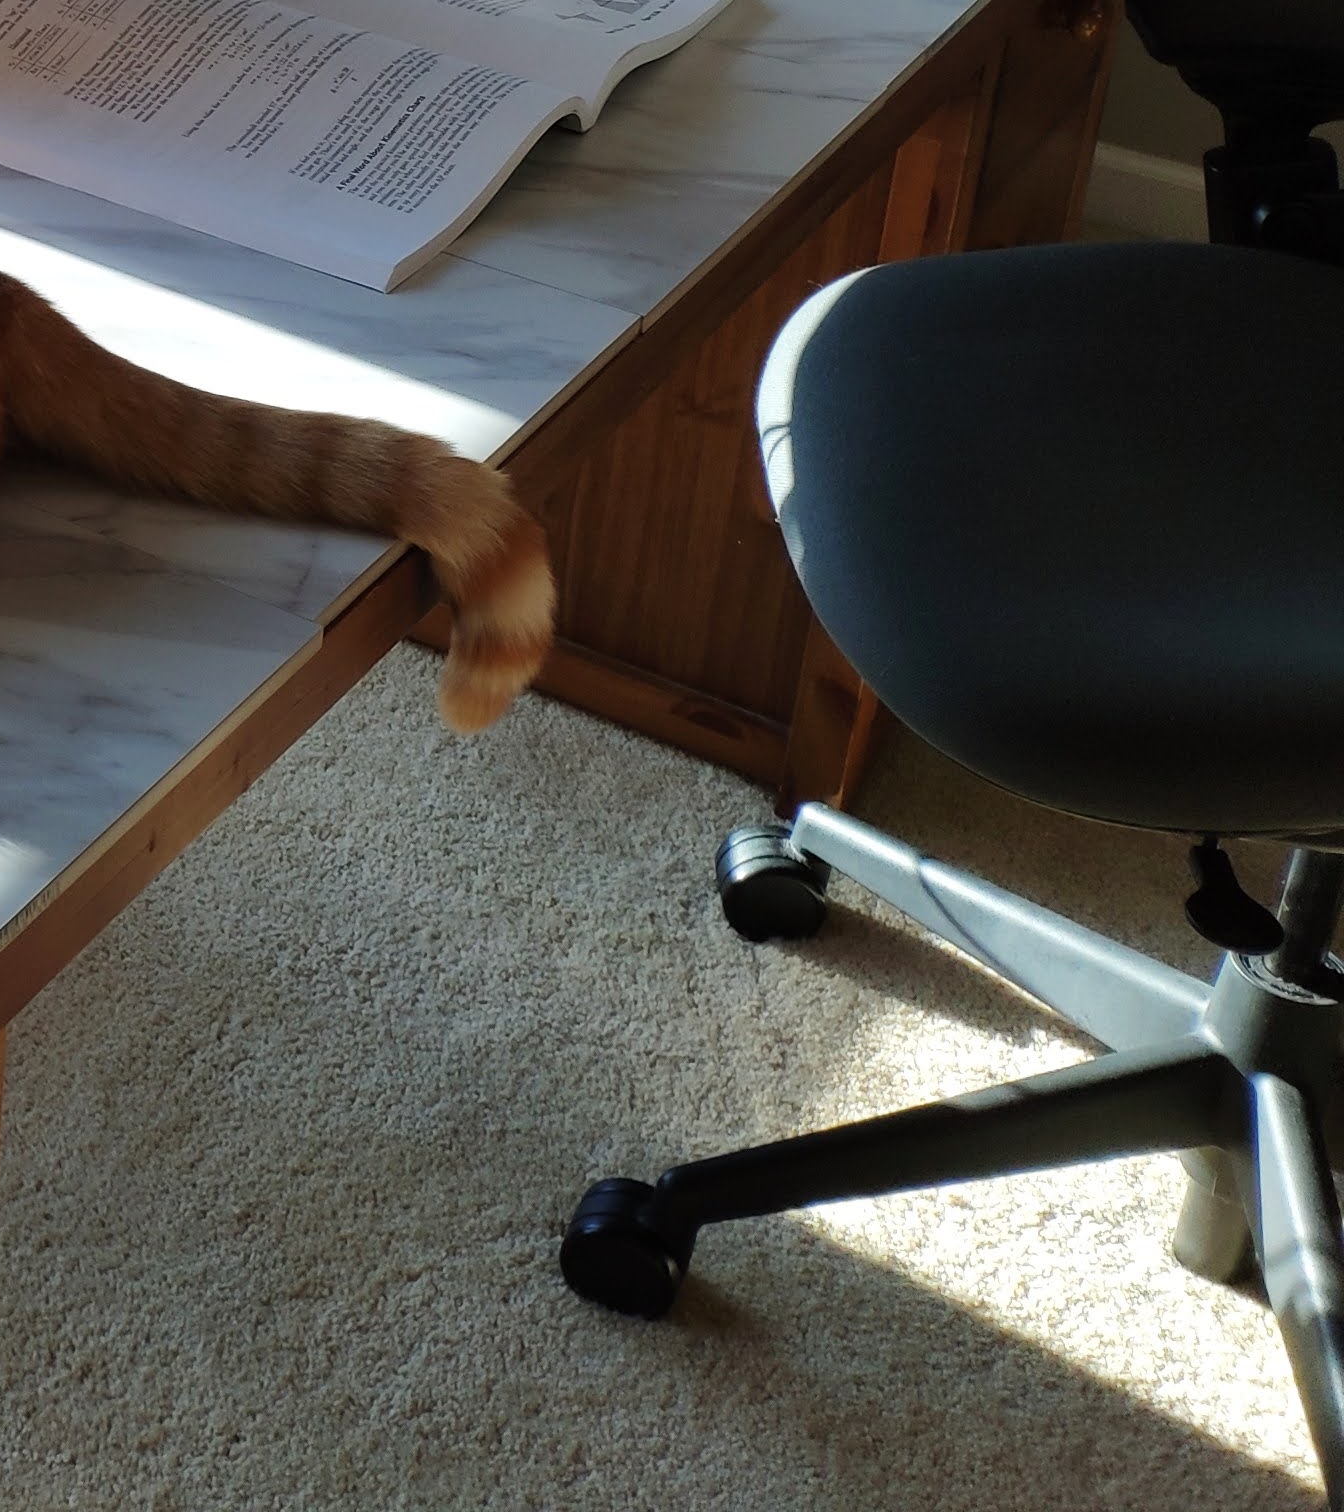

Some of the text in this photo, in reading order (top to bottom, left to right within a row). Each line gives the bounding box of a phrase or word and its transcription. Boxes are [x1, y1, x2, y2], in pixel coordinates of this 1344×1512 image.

[340, 174, 356, 186] Final
[352, 160, 370, 174] Word
[367, 143, 385, 159] About
[381, 114, 410, 142] Kinematics
[407, 96, 425, 112] Charts
